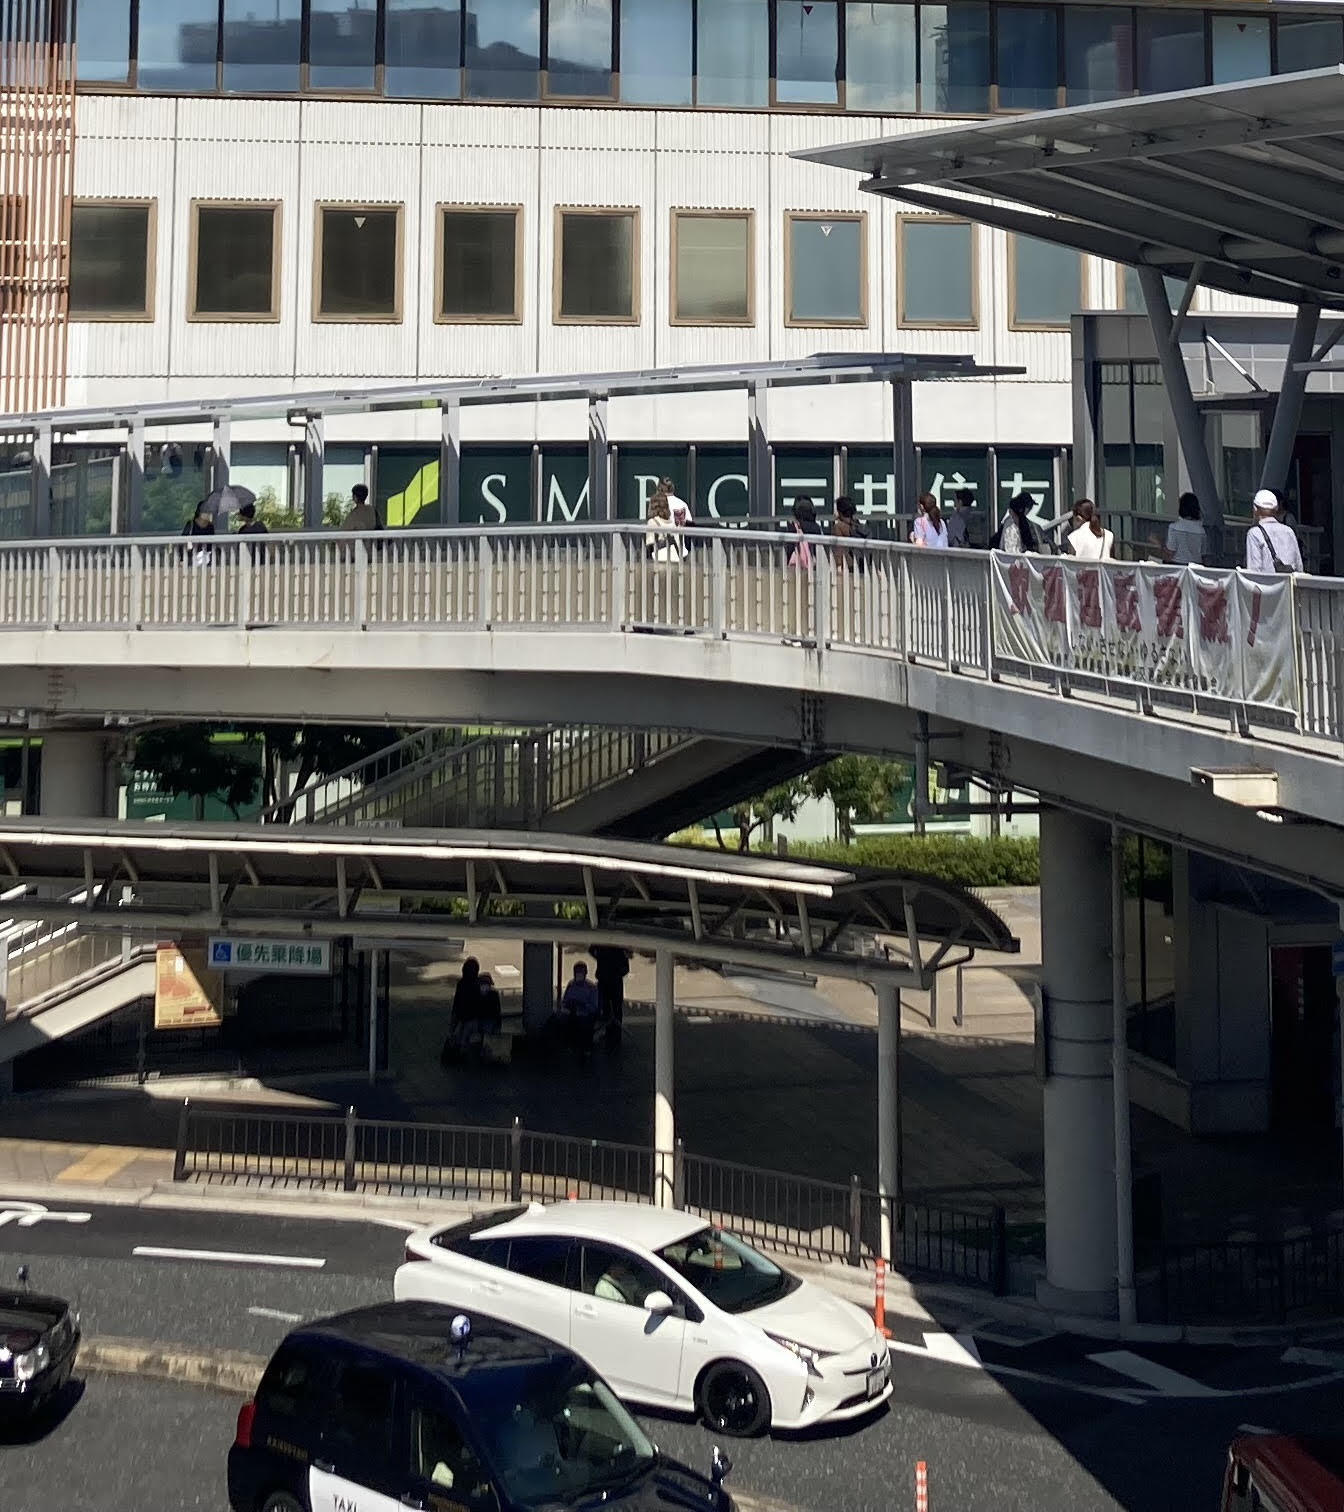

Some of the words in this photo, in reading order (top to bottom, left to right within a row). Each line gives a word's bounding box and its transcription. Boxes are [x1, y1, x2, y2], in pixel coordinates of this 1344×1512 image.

[236, 942, 323, 967] 優先乗降場
